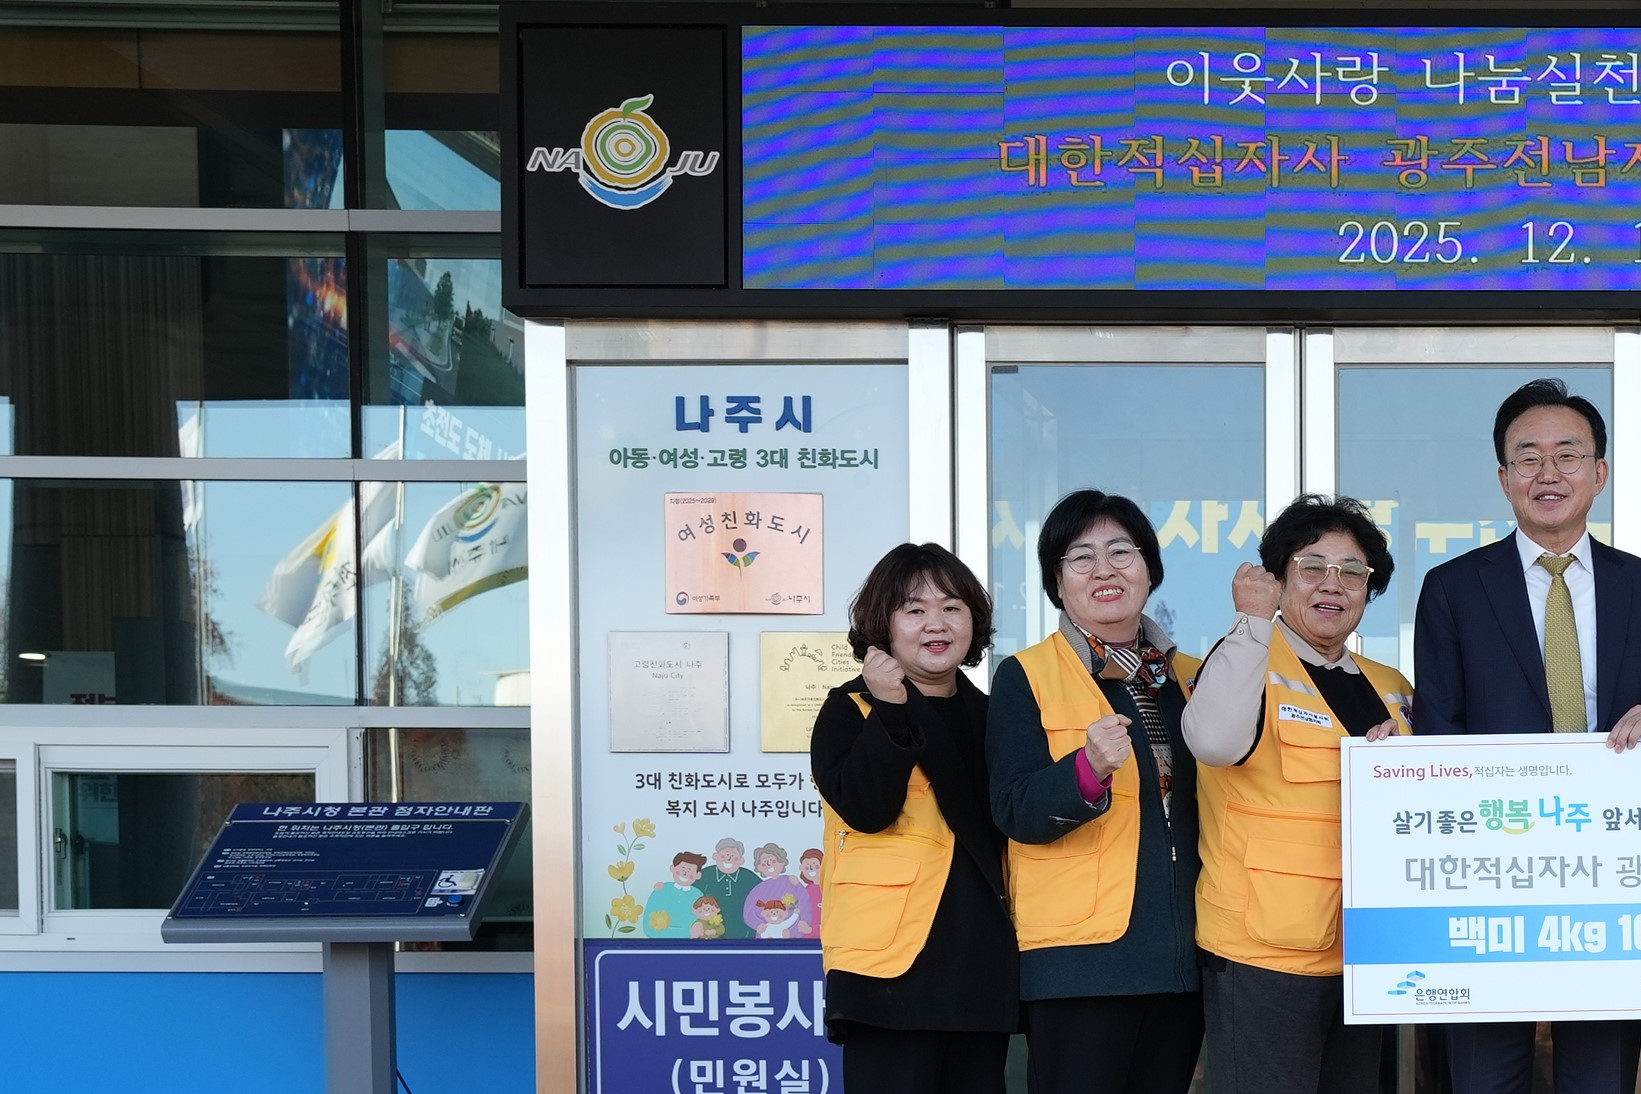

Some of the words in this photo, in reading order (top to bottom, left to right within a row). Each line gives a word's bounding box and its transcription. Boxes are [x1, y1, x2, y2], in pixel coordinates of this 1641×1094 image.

[1166, 52, 1389, 105] 이웃사랑
[527, 147, 583, 172] NA
[670, 151, 720, 176] JU
[998, 134, 1347, 188] 대한적십자사
[1338, 221, 1478, 265] 2025.
[1521, 221, 1591, 265] 12.
[675, 395, 812, 433] 나주시
[756, 448, 789, 470] 3대
[797, 448, 880, 470] 친화도시
[678, 510, 811, 545] 여성친화도시
[788, 595, 811, 603] 나주시
[670, 672, 684, 680] City
[635, 773, 662, 790] 3대
[666, 772, 750, 791] 친화도시로
[754, 772, 805, 791] 모두가
[1373, 765, 1426, 781] Saving
[1430, 764, 1473, 780] Lives,
[1474, 766, 1515, 777] 적십자는
[1518, 765, 1573, 777] 생명입니다.
[261, 806, 342, 817] 나주시청
[347, 806, 389, 817] 본관
[394, 806, 494, 817] 점자안내판
[666, 799, 698, 818] 복지
[703, 799, 736, 818] 도시
[741, 799, 823, 818] 나주입니다
[1405, 854, 1604, 891] 대한적십자사
[1448, 916, 1526, 954] 백미
[1537, 914, 1607, 953] 4kg
[1414, 988, 1470, 1002] 은행연합회
